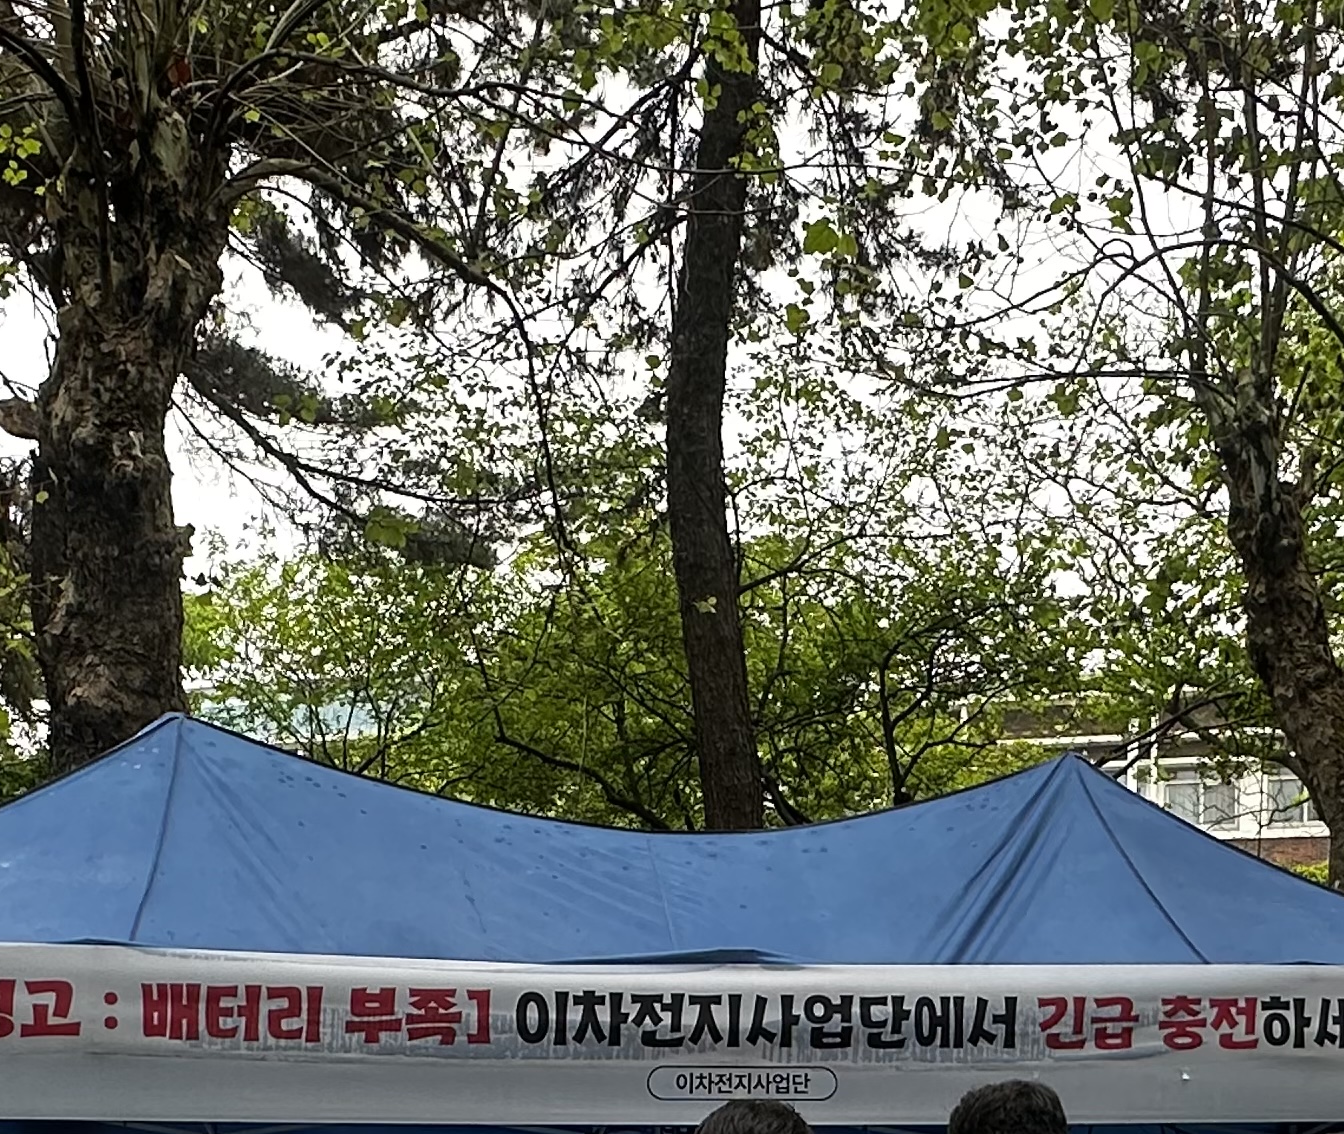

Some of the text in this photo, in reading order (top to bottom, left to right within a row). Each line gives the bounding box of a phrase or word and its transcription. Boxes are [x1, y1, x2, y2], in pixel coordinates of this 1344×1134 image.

[141, 982, 323, 1043] 배터리
[345, 986, 492, 1044] 부족]
[516, 990, 1017, 1050] 이차전지사업단에서
[1037, 995, 1140, 1050] 긴급
[675, 1072, 811, 1096] 이차전지사업단
